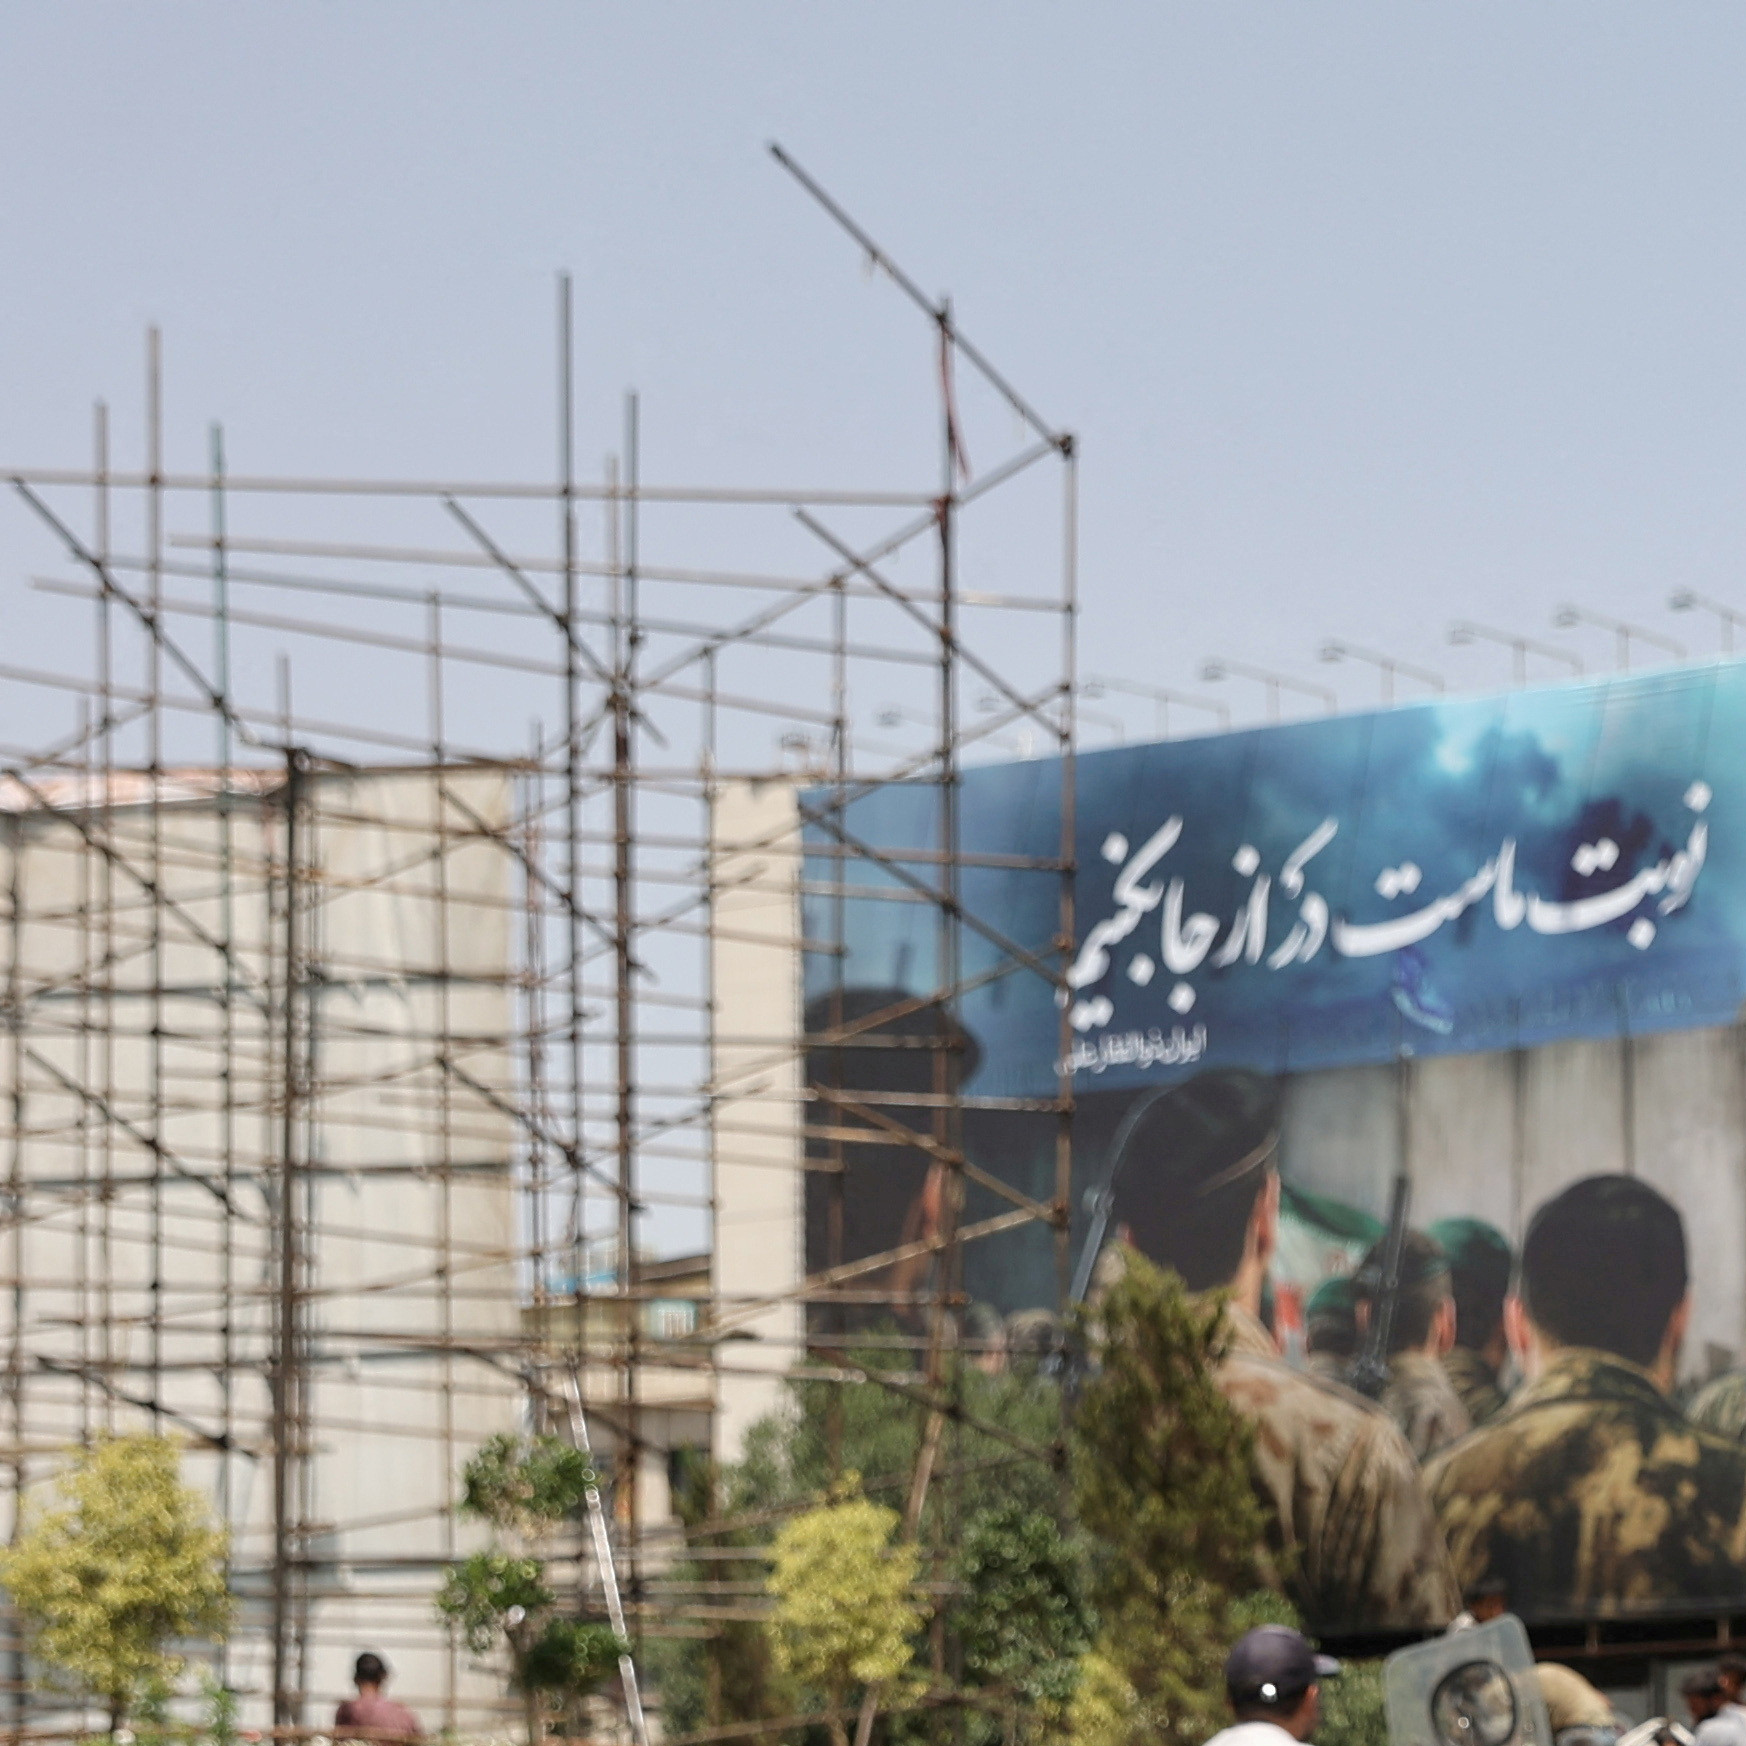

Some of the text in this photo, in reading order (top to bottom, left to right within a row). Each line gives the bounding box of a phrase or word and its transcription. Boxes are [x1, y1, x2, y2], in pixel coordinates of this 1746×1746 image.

[1208, 841, 1272, 969] از
[1331, 836, 1527, 959] ماست
[1527, 780, 1713, 950] نوبت
